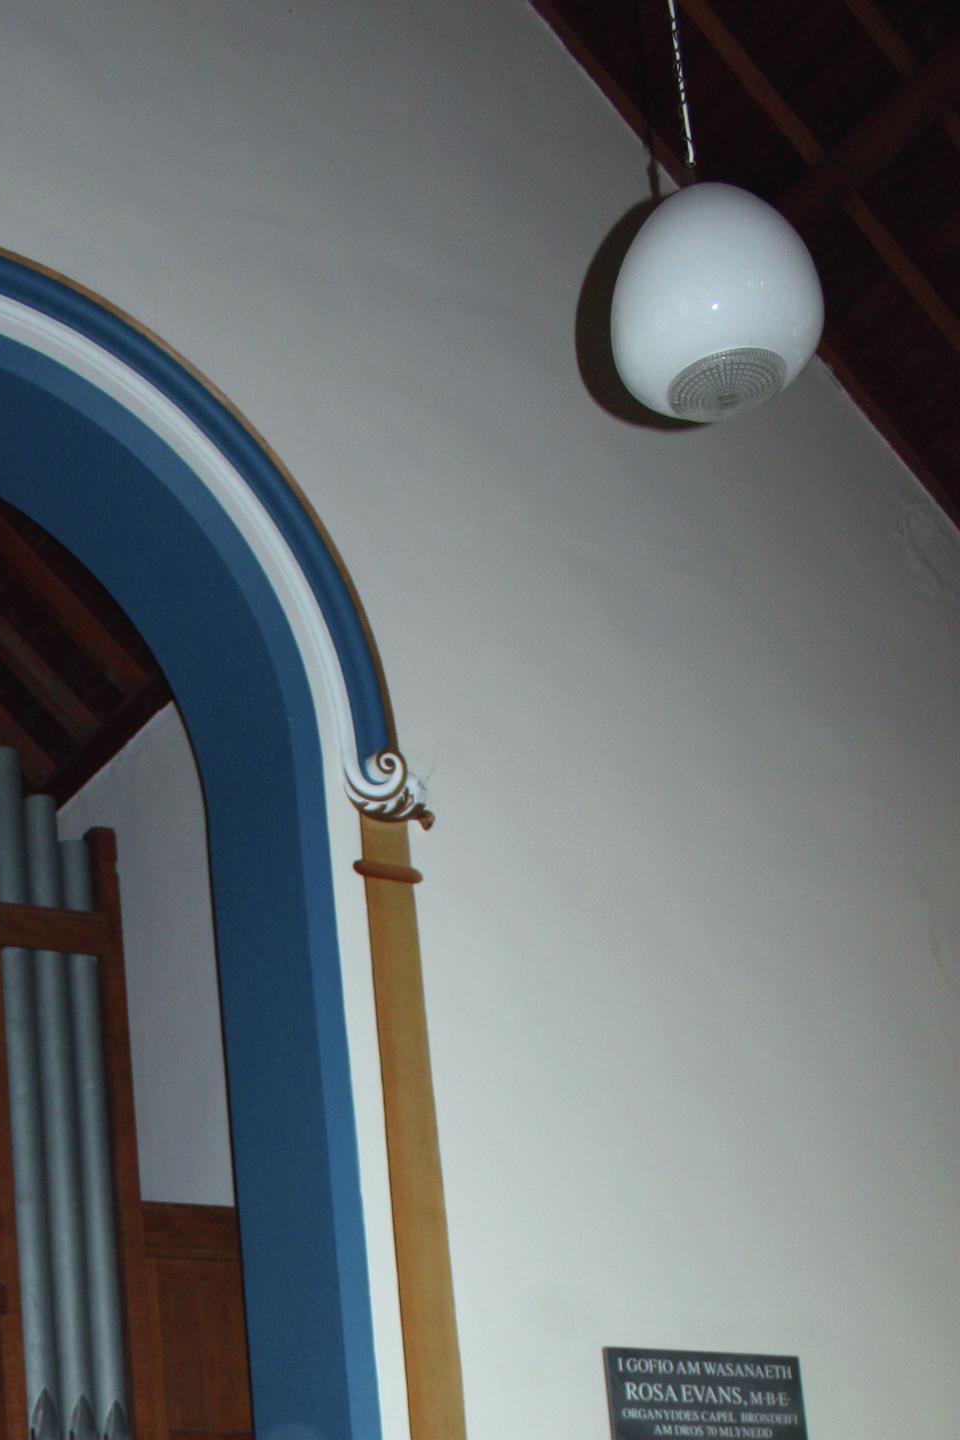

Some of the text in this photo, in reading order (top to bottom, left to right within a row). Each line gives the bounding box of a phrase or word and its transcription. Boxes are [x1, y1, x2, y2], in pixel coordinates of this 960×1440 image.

[617, 1357, 792, 1379] I GOFIO AM WASANAETH
[625, 1381, 678, 1402] ROSA
[680, 1384, 748, 1407] EVANS,
[621, 1407, 699, 1421] ORGANYDDES
[701, 1410, 735, 1424] CAPEL
[653, 1424, 672, 1436] AM
[674, 1424, 704, 1438] DROS
[719, 1425, 773, 1439] MLYNEDD
